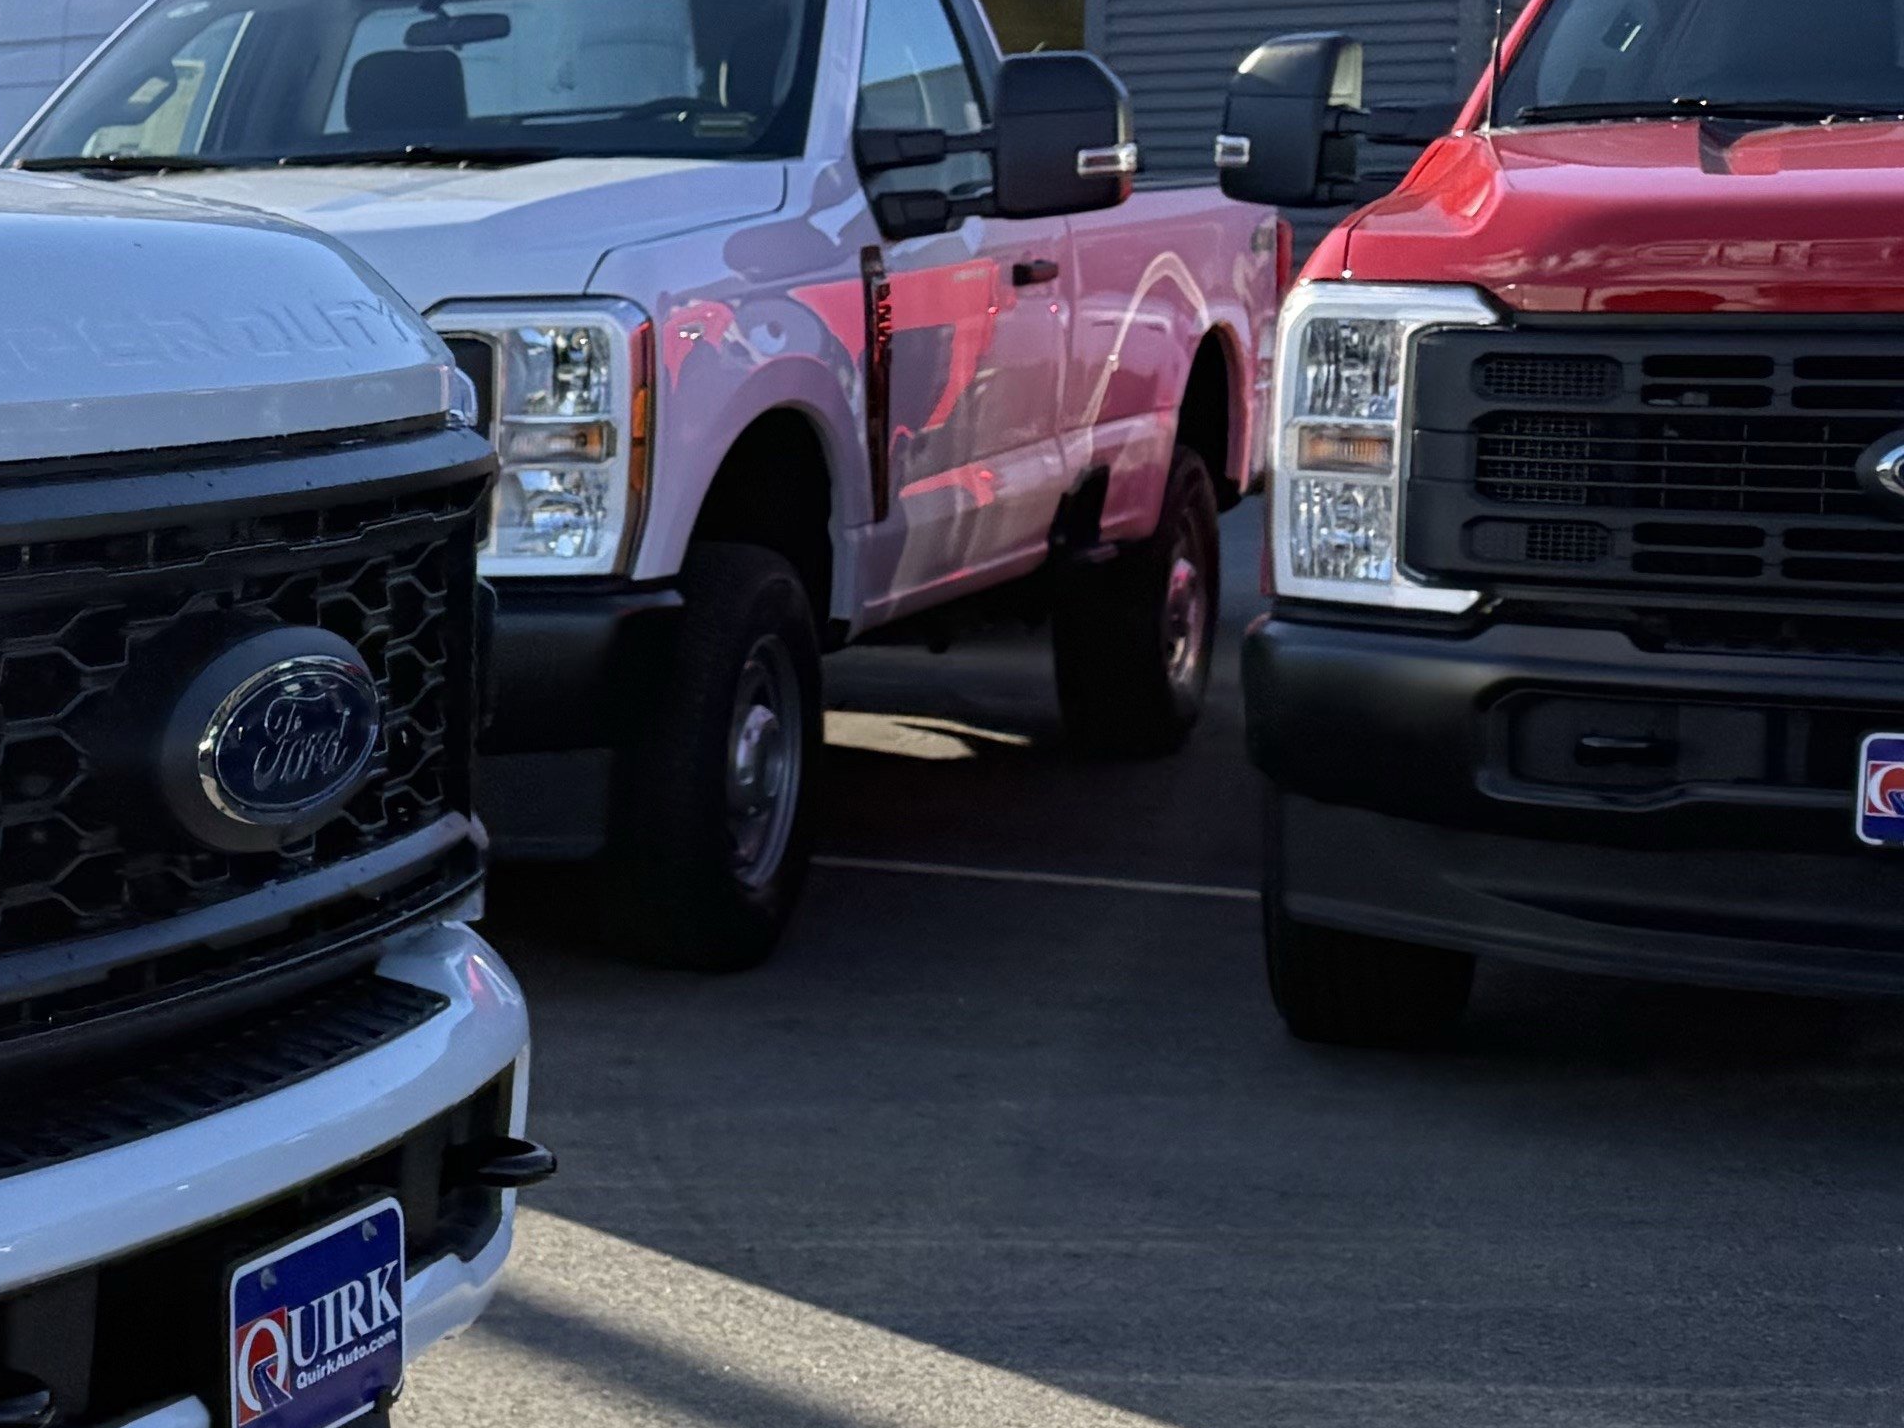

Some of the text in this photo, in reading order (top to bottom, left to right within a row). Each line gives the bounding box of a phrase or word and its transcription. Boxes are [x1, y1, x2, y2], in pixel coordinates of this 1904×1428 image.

[252, 692, 352, 791] Ford
[238, 1260, 401, 1412] QUIRK
[296, 1329, 397, 1390] QuirkAuto.com
